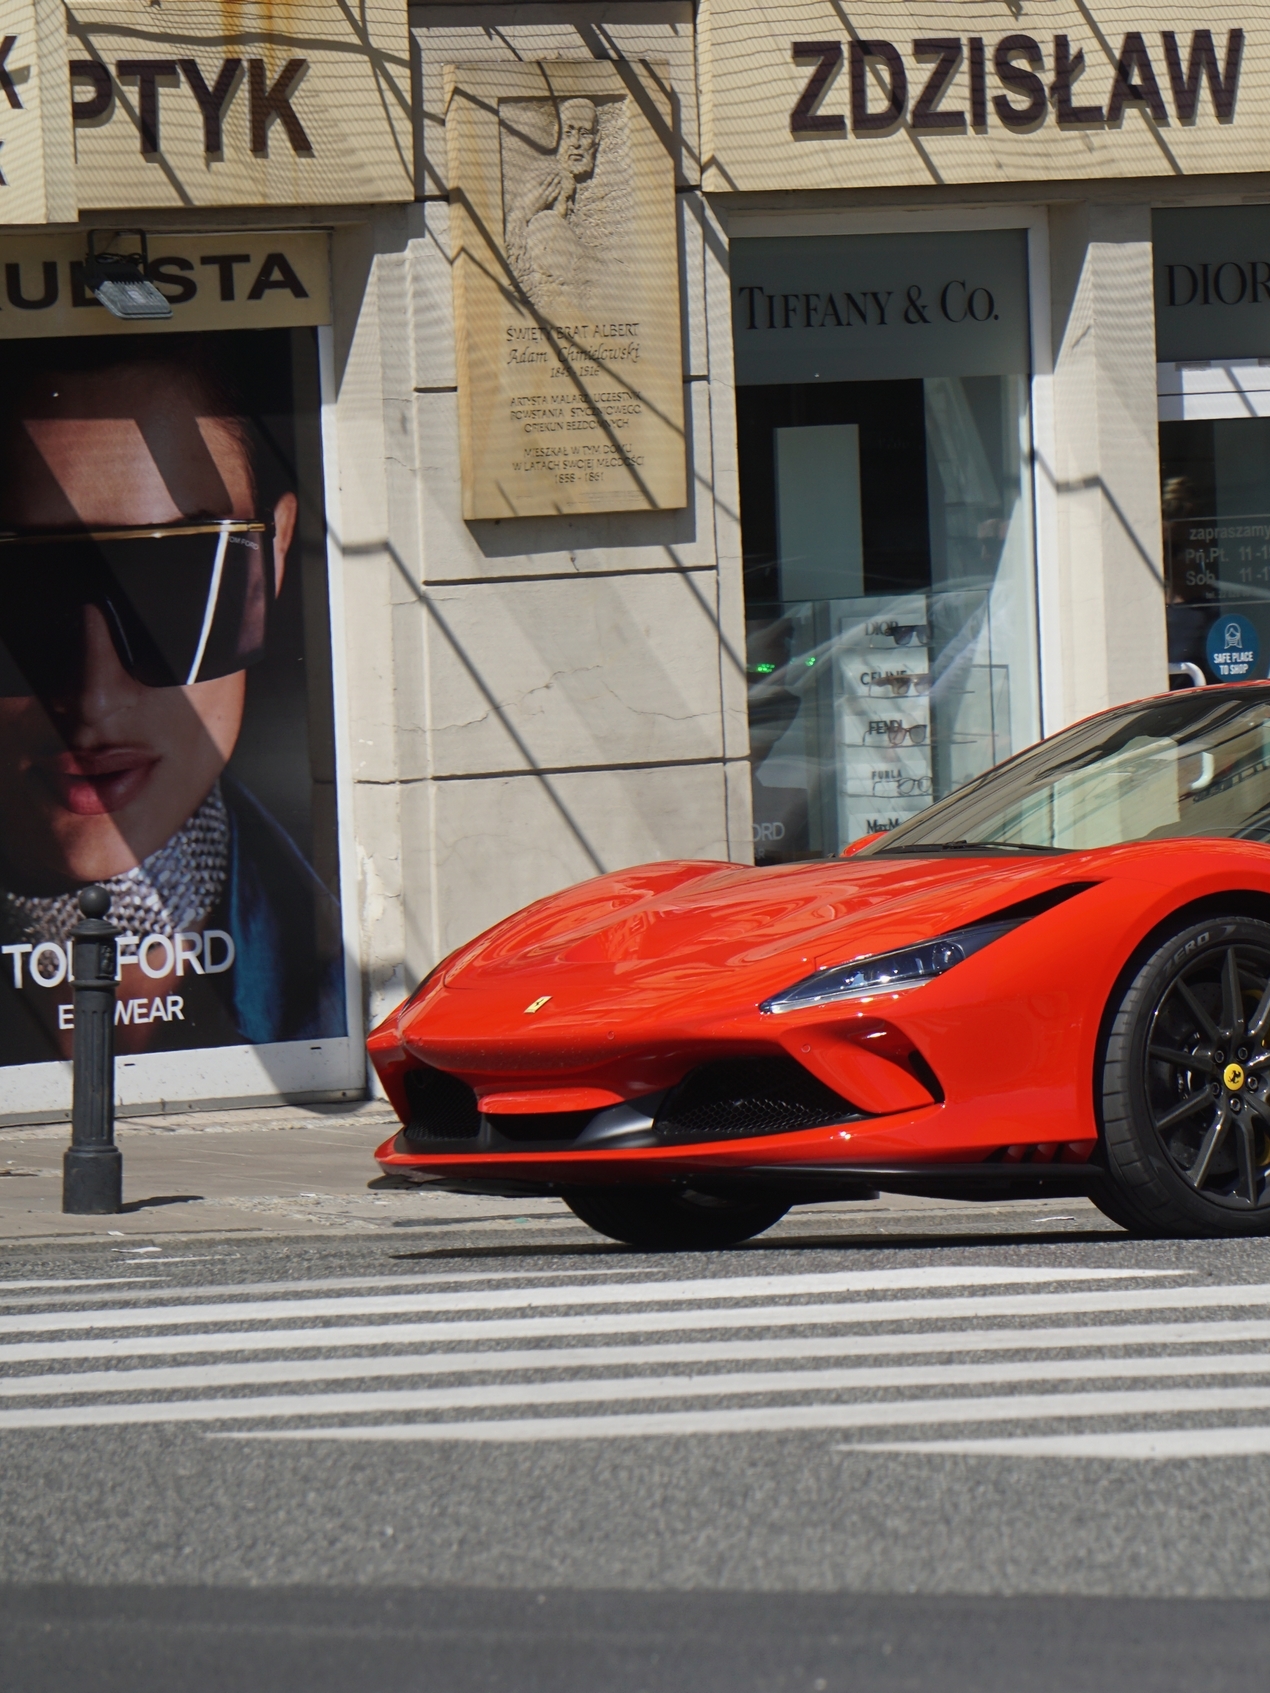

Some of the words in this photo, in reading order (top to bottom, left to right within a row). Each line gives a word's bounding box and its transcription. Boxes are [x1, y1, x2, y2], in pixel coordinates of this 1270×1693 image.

[791, 28, 1243, 133] ZDZISŁAW
[69, 58, 313, 156] PTYK
[0, 253, 309, 310] ULSTA
[739, 285, 893, 331] TIFFANY
[903, 284, 932, 325] &
[556, 325, 589, 339] BRAT
[593, 322, 640, 338] ALBERT
[507, 346, 548, 364] Adam
[558, 341, 640, 363] Chmielowski
[510, 395, 547, 407] ARTYSTA
[510, 409, 564, 420] POWSTANIA
[571, 446, 580, 455] W
[582, 445, 600, 455] TYM
[512, 461, 522, 471] W
[524, 460, 560, 472] LATACH
[1213, 653, 1232, 664] SAFE
[1232, 651, 1254, 662] PLACE
[1219, 664, 1229, 675] TO
[1230, 663, 1249, 675] SHOP
[872, 769, 903, 780] FURLA
[1, 941, 74, 989] TO
[115, 930, 235, 981] FORD
[1163, 931, 1210, 977] ZERO
[58, 995, 185, 1030] EWEAR
